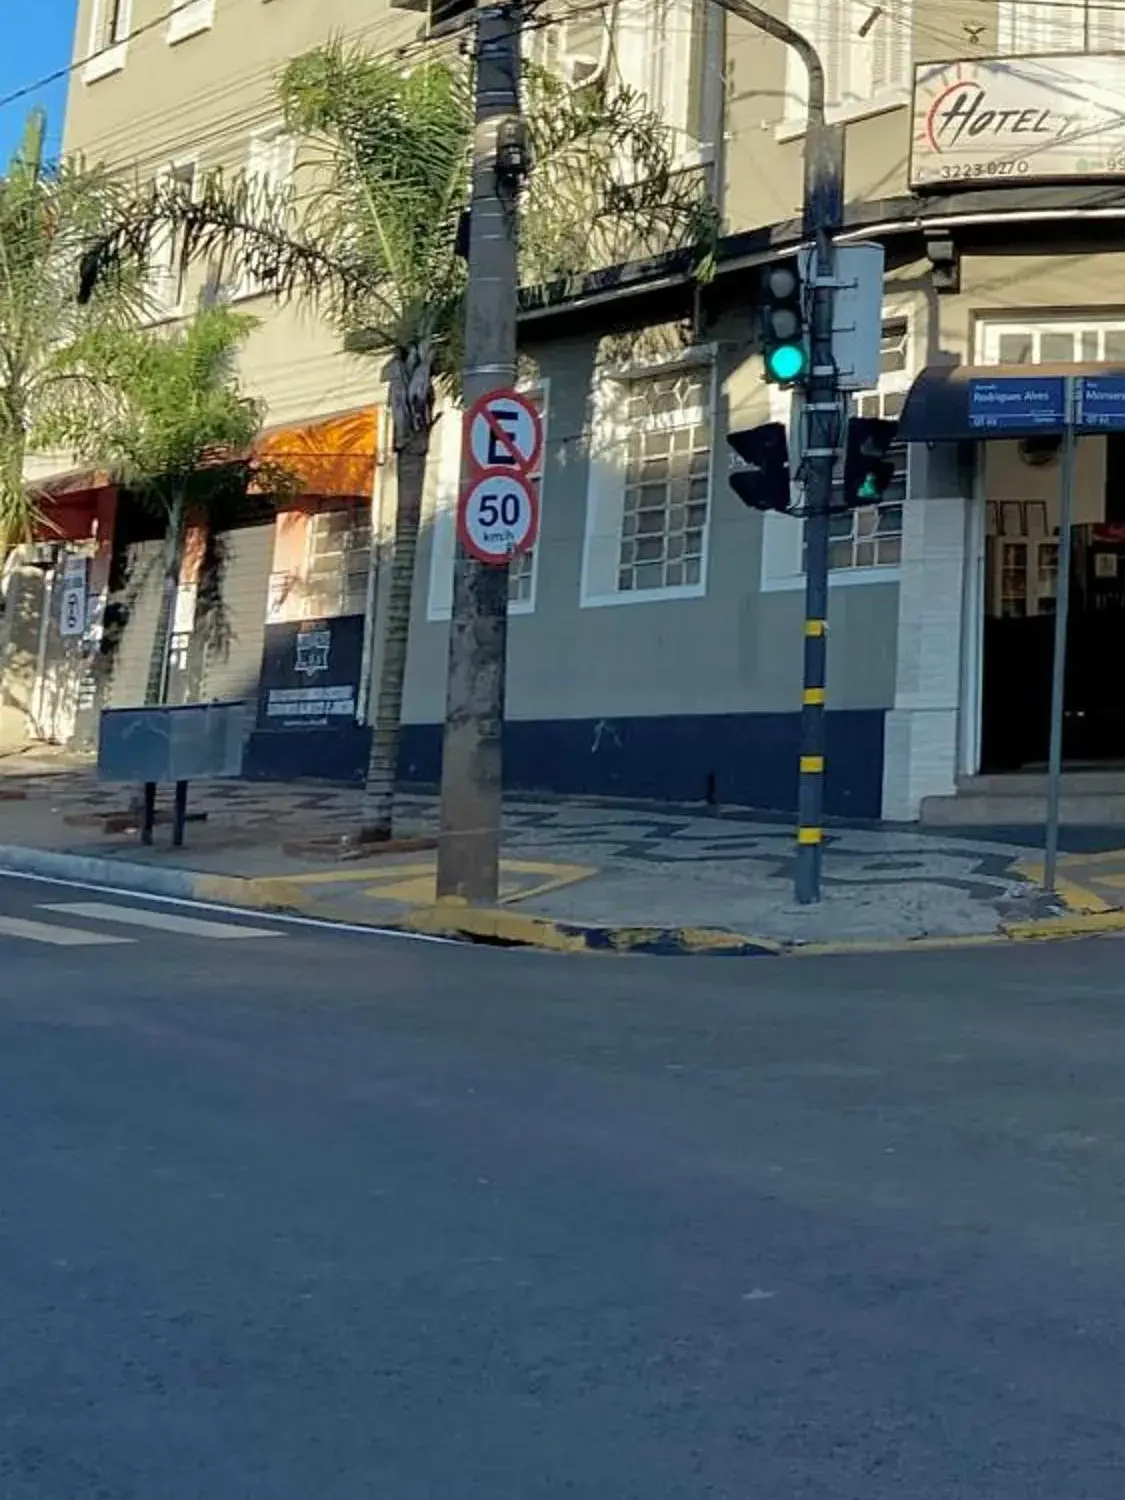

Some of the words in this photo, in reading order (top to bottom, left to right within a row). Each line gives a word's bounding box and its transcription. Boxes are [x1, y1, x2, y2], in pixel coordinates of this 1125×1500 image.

[938, 90, 1051, 147] HOTEL
[487, 411, 519, 464] E
[478, 493, 520, 527] 50
